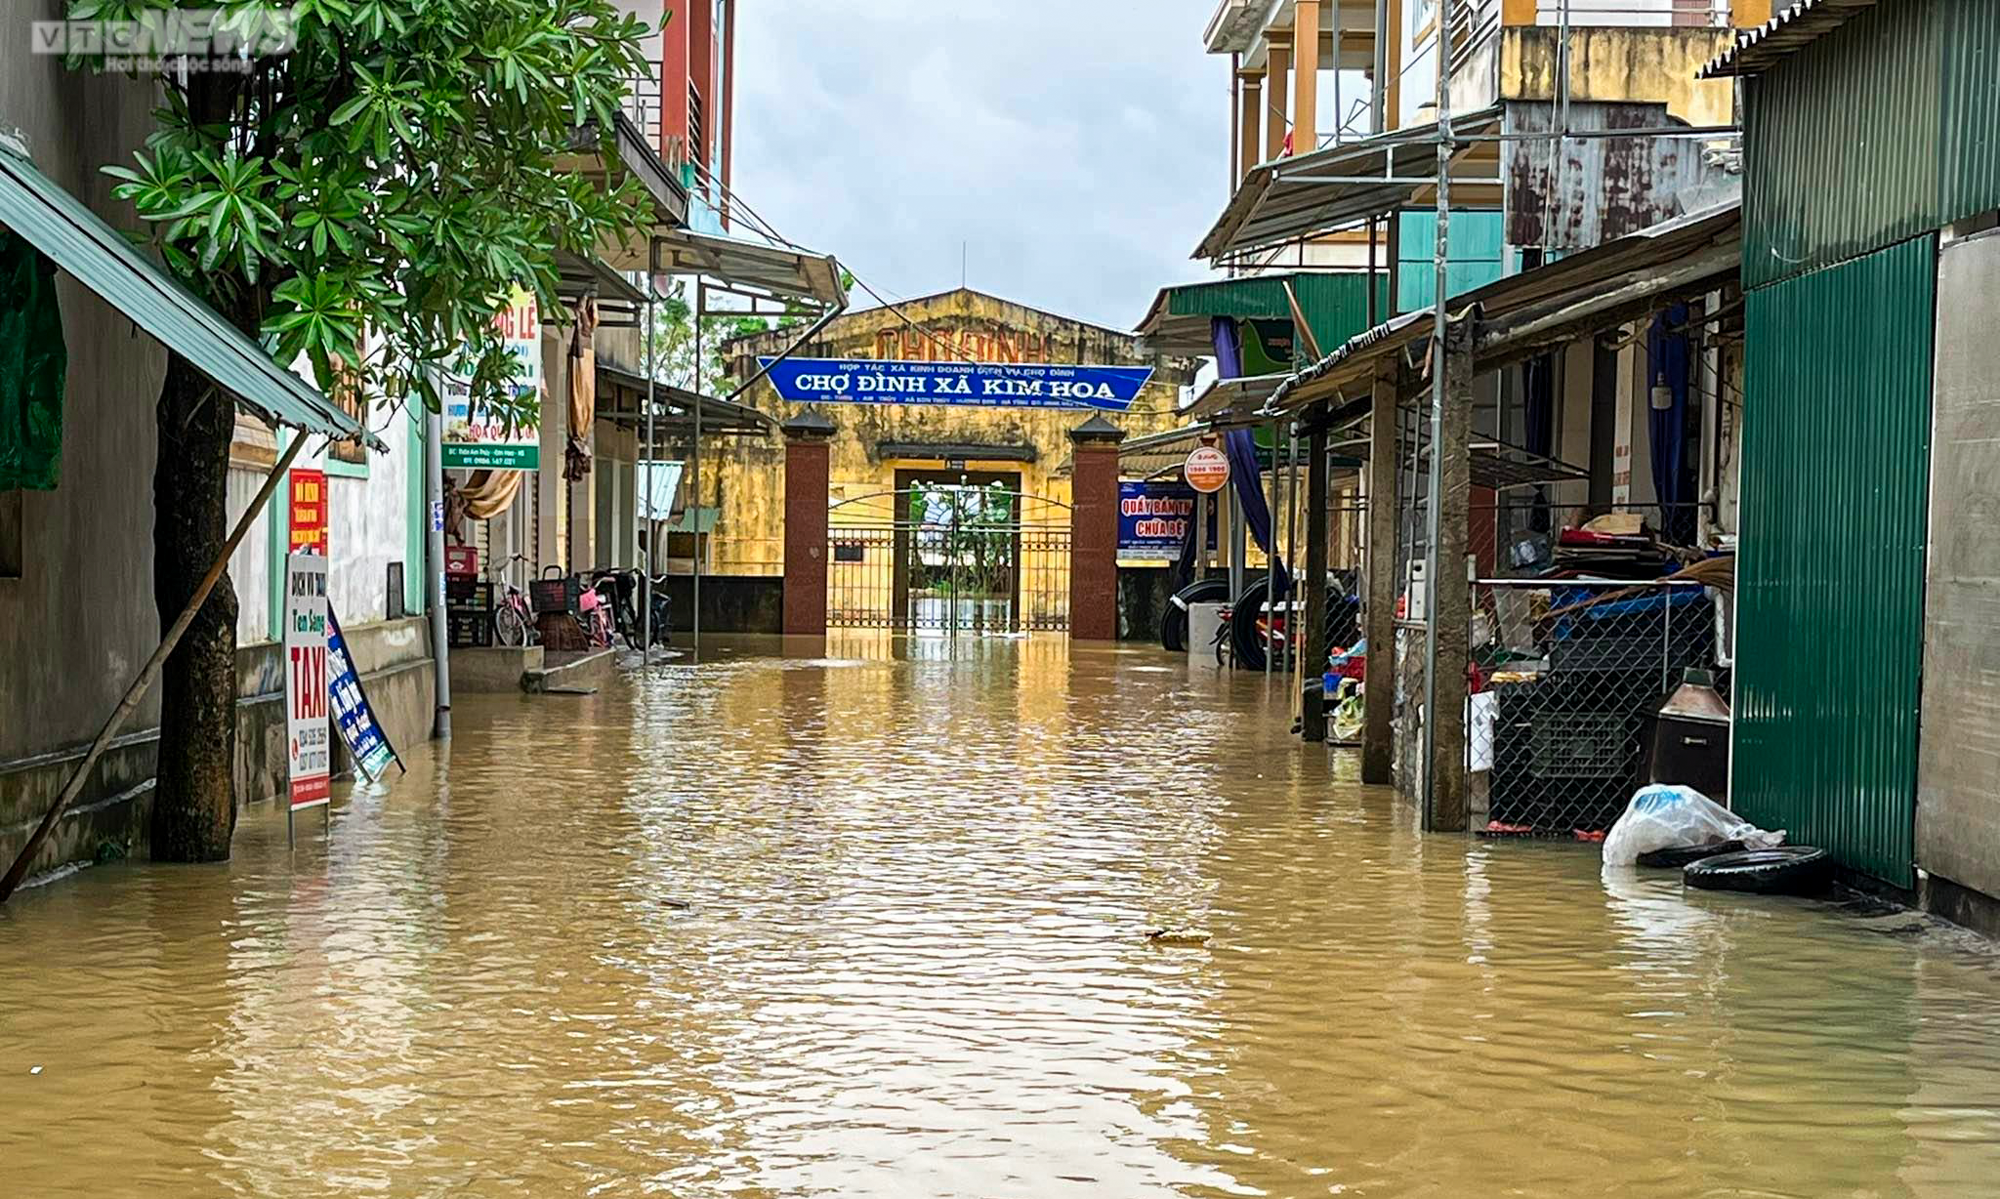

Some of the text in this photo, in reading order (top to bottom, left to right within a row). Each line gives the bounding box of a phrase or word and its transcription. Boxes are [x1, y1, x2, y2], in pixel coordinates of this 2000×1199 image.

[839, 364, 860, 372] HỢP
[864, 363, 885, 372] TÁC
[890, 363, 906, 372] XÃ
[910, 365, 935, 373] KINH
[937, 366, 974, 375] DOANH
[795, 372, 1115, 398] CHỢ ĐÌNH XÃ KIM HOA
[1153, 497, 1175, 515] BÁN
[290, 646, 326, 720] TAXI
